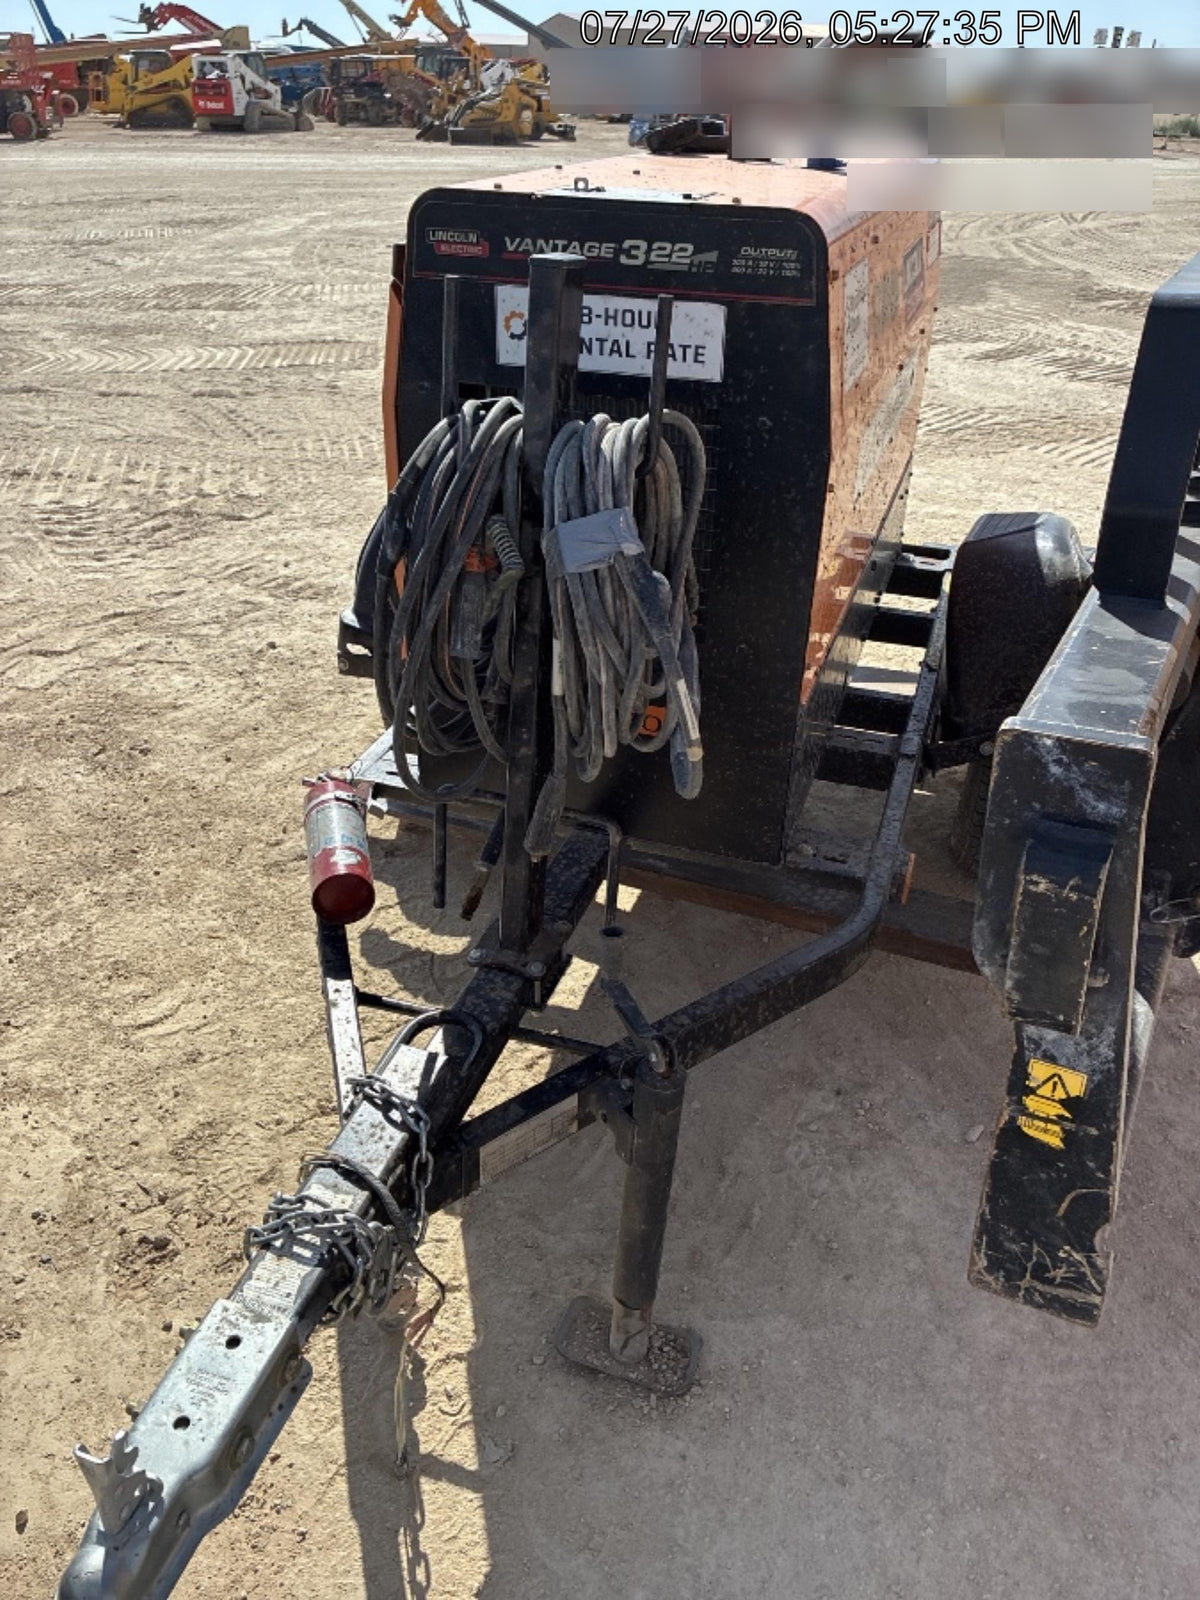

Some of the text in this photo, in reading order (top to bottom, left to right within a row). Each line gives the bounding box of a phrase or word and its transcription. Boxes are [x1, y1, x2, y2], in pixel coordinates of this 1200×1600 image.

[429, 230, 478, 243] LINCOLN
[440, 243, 484, 255] ELECTRIC
[504, 236, 616, 257] VANTAGE
[619, 239, 694, 265] 322
